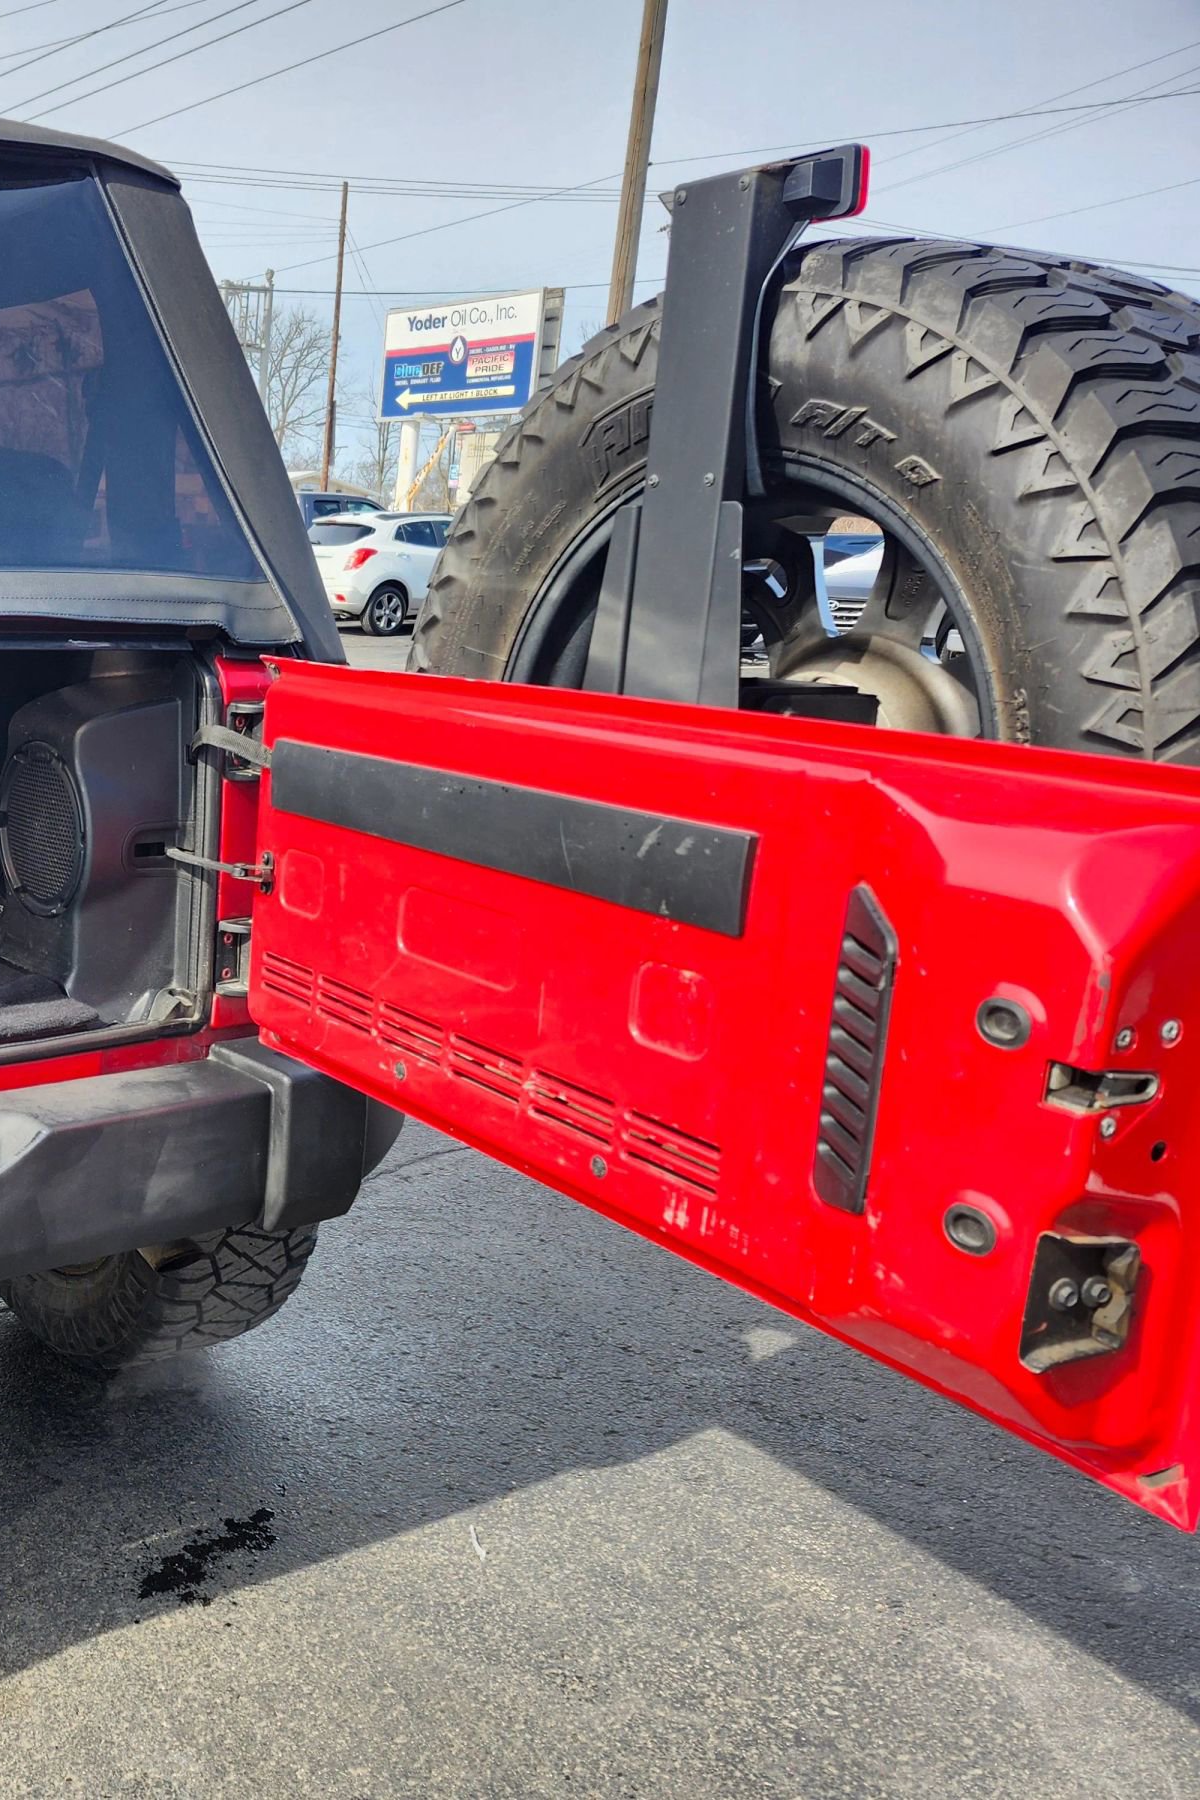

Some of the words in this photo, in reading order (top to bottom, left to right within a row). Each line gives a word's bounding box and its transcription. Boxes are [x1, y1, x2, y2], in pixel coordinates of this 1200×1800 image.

[407, 314, 448, 332] Yoder
[450, 309, 467, 327] Oil
[469, 307, 494, 324] Co.,
[496, 303, 517, 320] Inc.
[471, 353, 509, 365] PACIFIC
[474, 363, 504, 374] PRIDE
[422, 393, 438, 401] LEFT
[440, 392, 448, 400] AT
[449, 390, 469, 399] LIGHT
[476, 388, 498, 397] BLOCK
